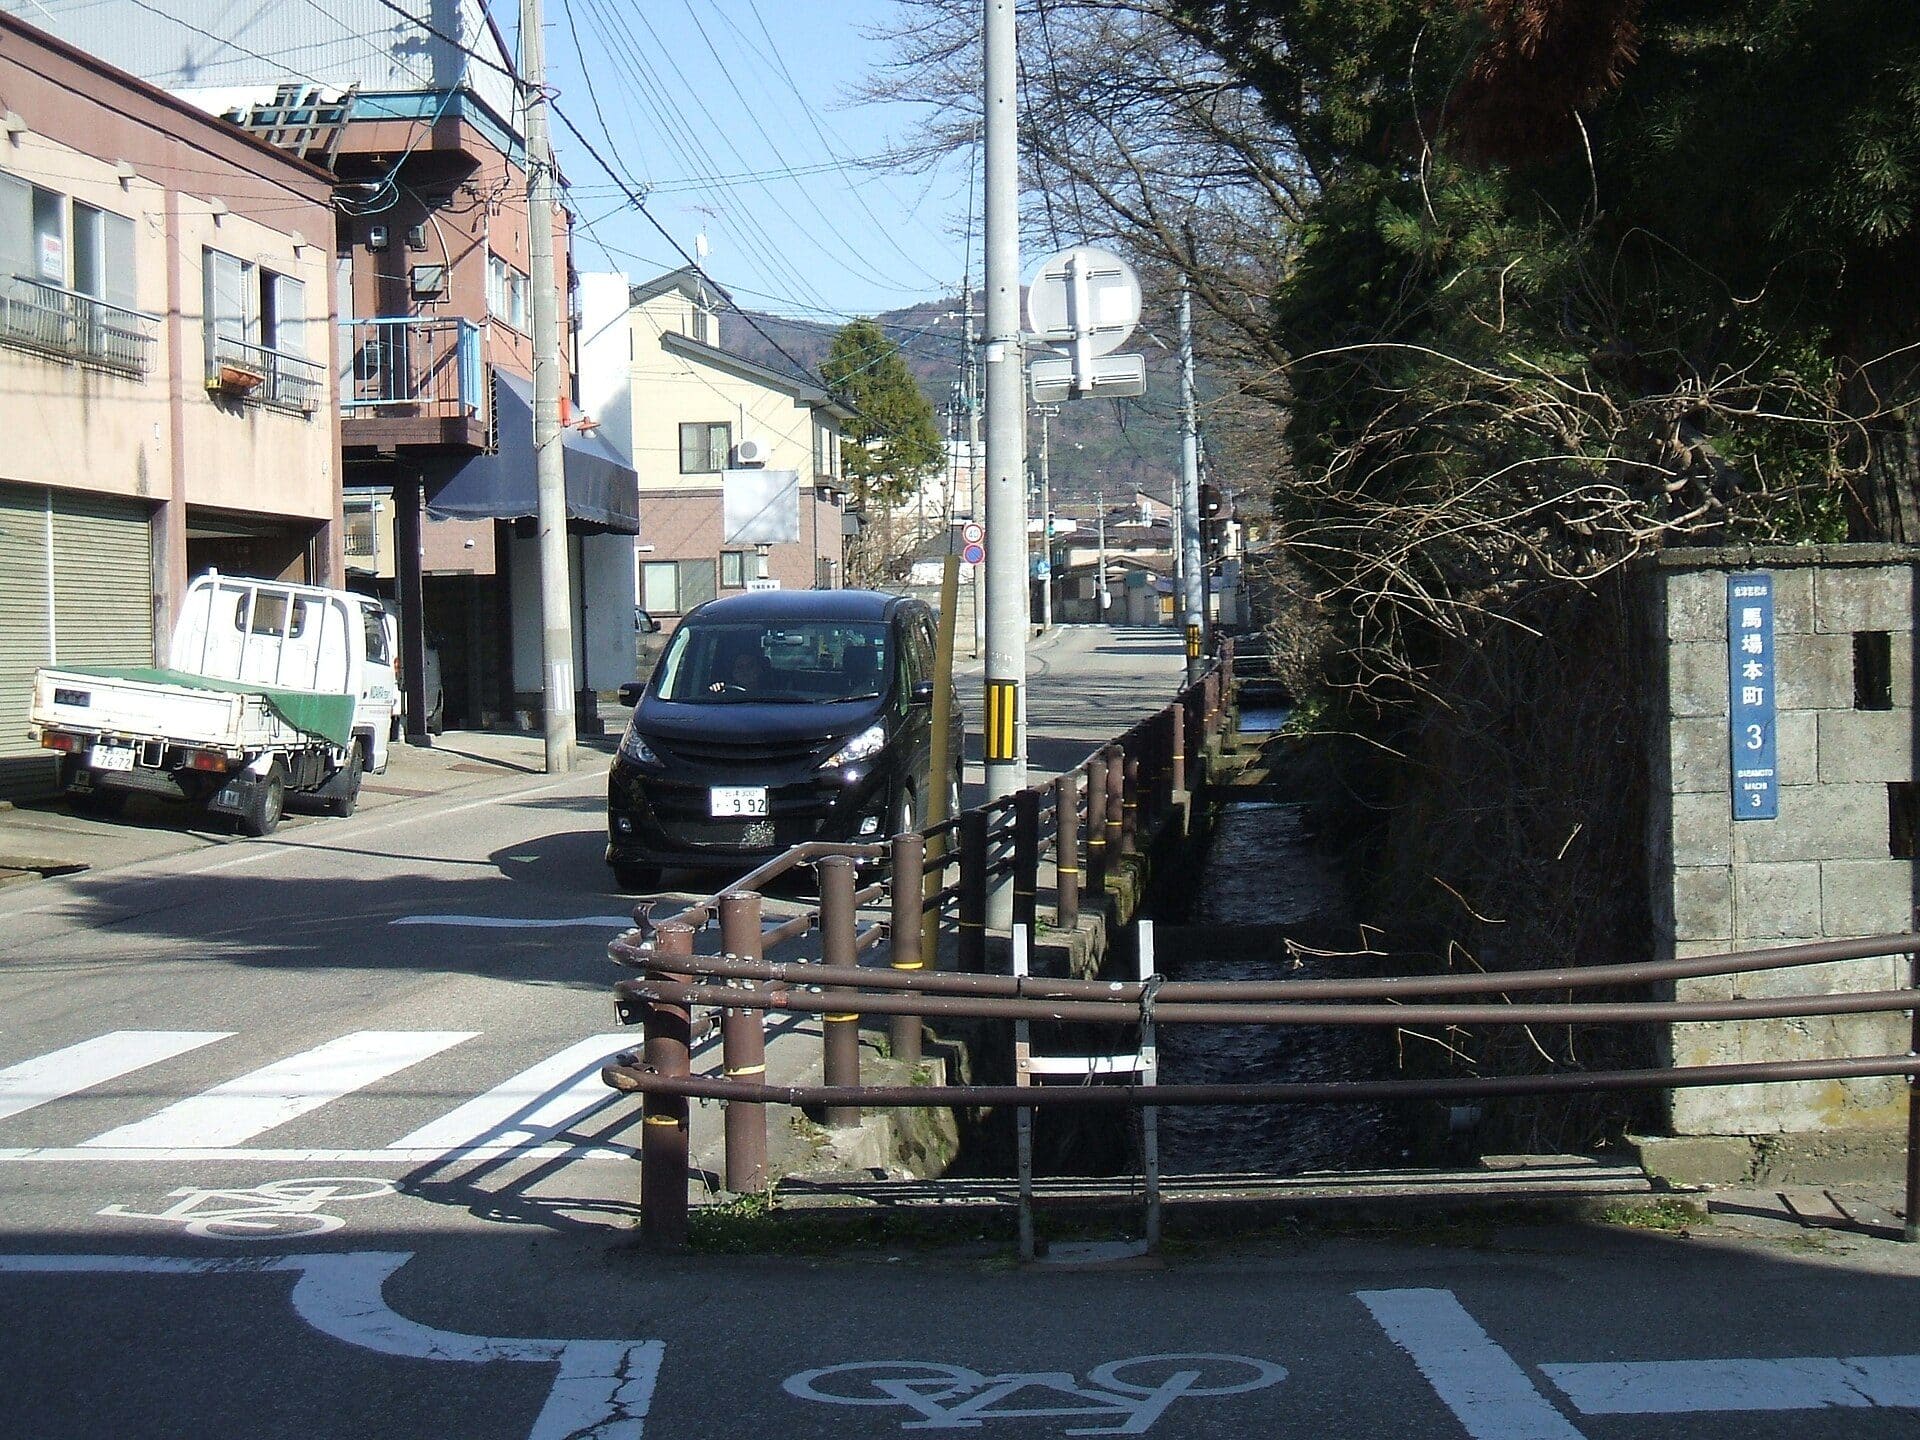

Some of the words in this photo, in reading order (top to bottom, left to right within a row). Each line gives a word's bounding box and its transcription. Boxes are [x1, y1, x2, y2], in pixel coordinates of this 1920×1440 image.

[968, 529, 979, 538] 40
[1742, 607, 1764, 706] 馬場本町
[1746, 724, 1763, 750] 3
[1751, 793, 1762, 807] 3
